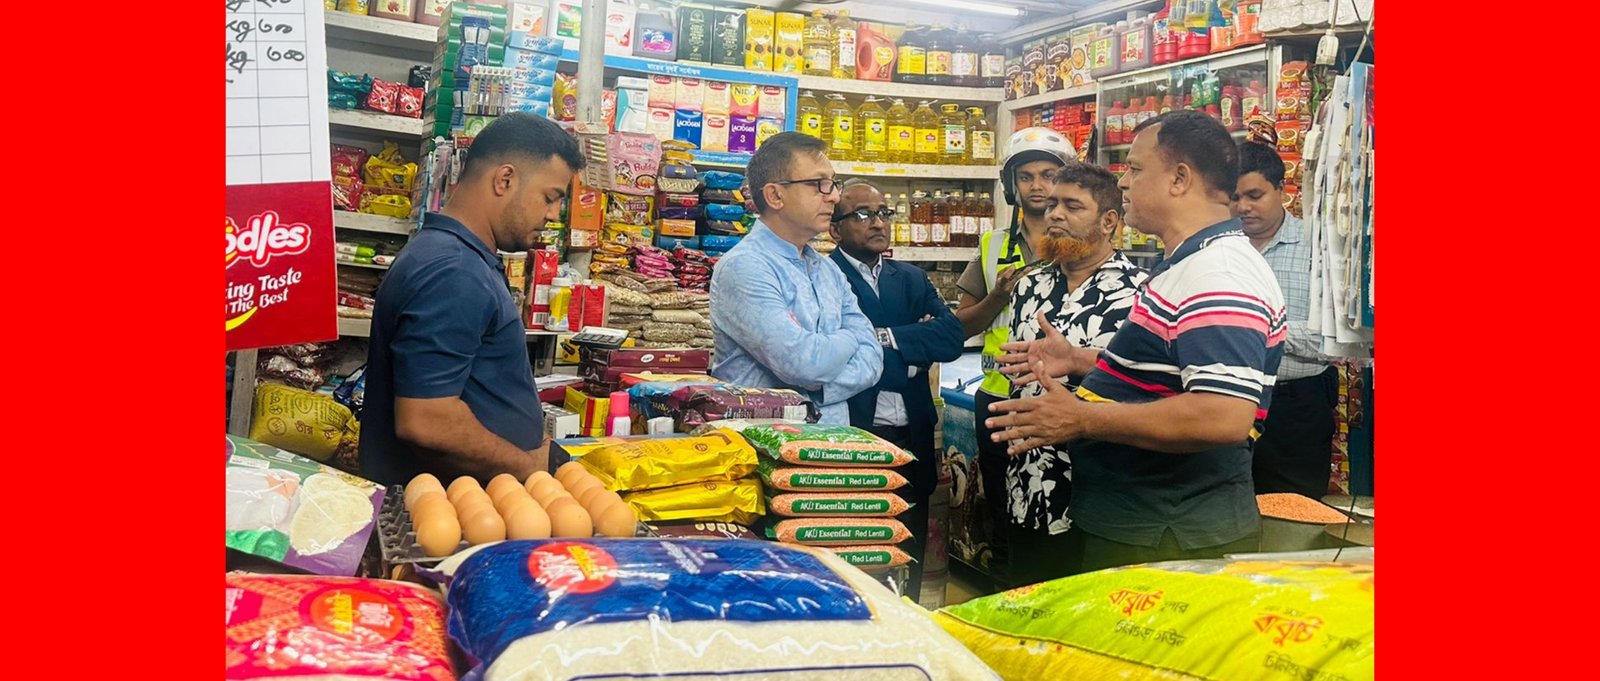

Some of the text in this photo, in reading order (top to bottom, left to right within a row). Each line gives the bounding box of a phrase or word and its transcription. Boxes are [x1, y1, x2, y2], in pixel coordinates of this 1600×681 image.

[739, 134, 746, 143] 3
[226, 266, 302, 302] ing Taste
[229, 287, 289, 314] The Best
[821, 450, 853, 460] Essential
[856, 453, 869, 461] Red
[869, 453, 886, 461] Lentil
[813, 476, 845, 485] Essential
[849, 477, 862, 485] Red
[862, 477, 880, 485] Lentil
[815, 501, 848, 510] Essential
[851, 502, 864, 510] Red
[864, 502, 881, 510] Lentil
[818, 529, 851, 538] Essential
[855, 530, 868, 538] Red
[868, 530, 885, 538] Lentil
[852, 554, 864, 563] Red
[865, 554, 883, 563] Lentil
